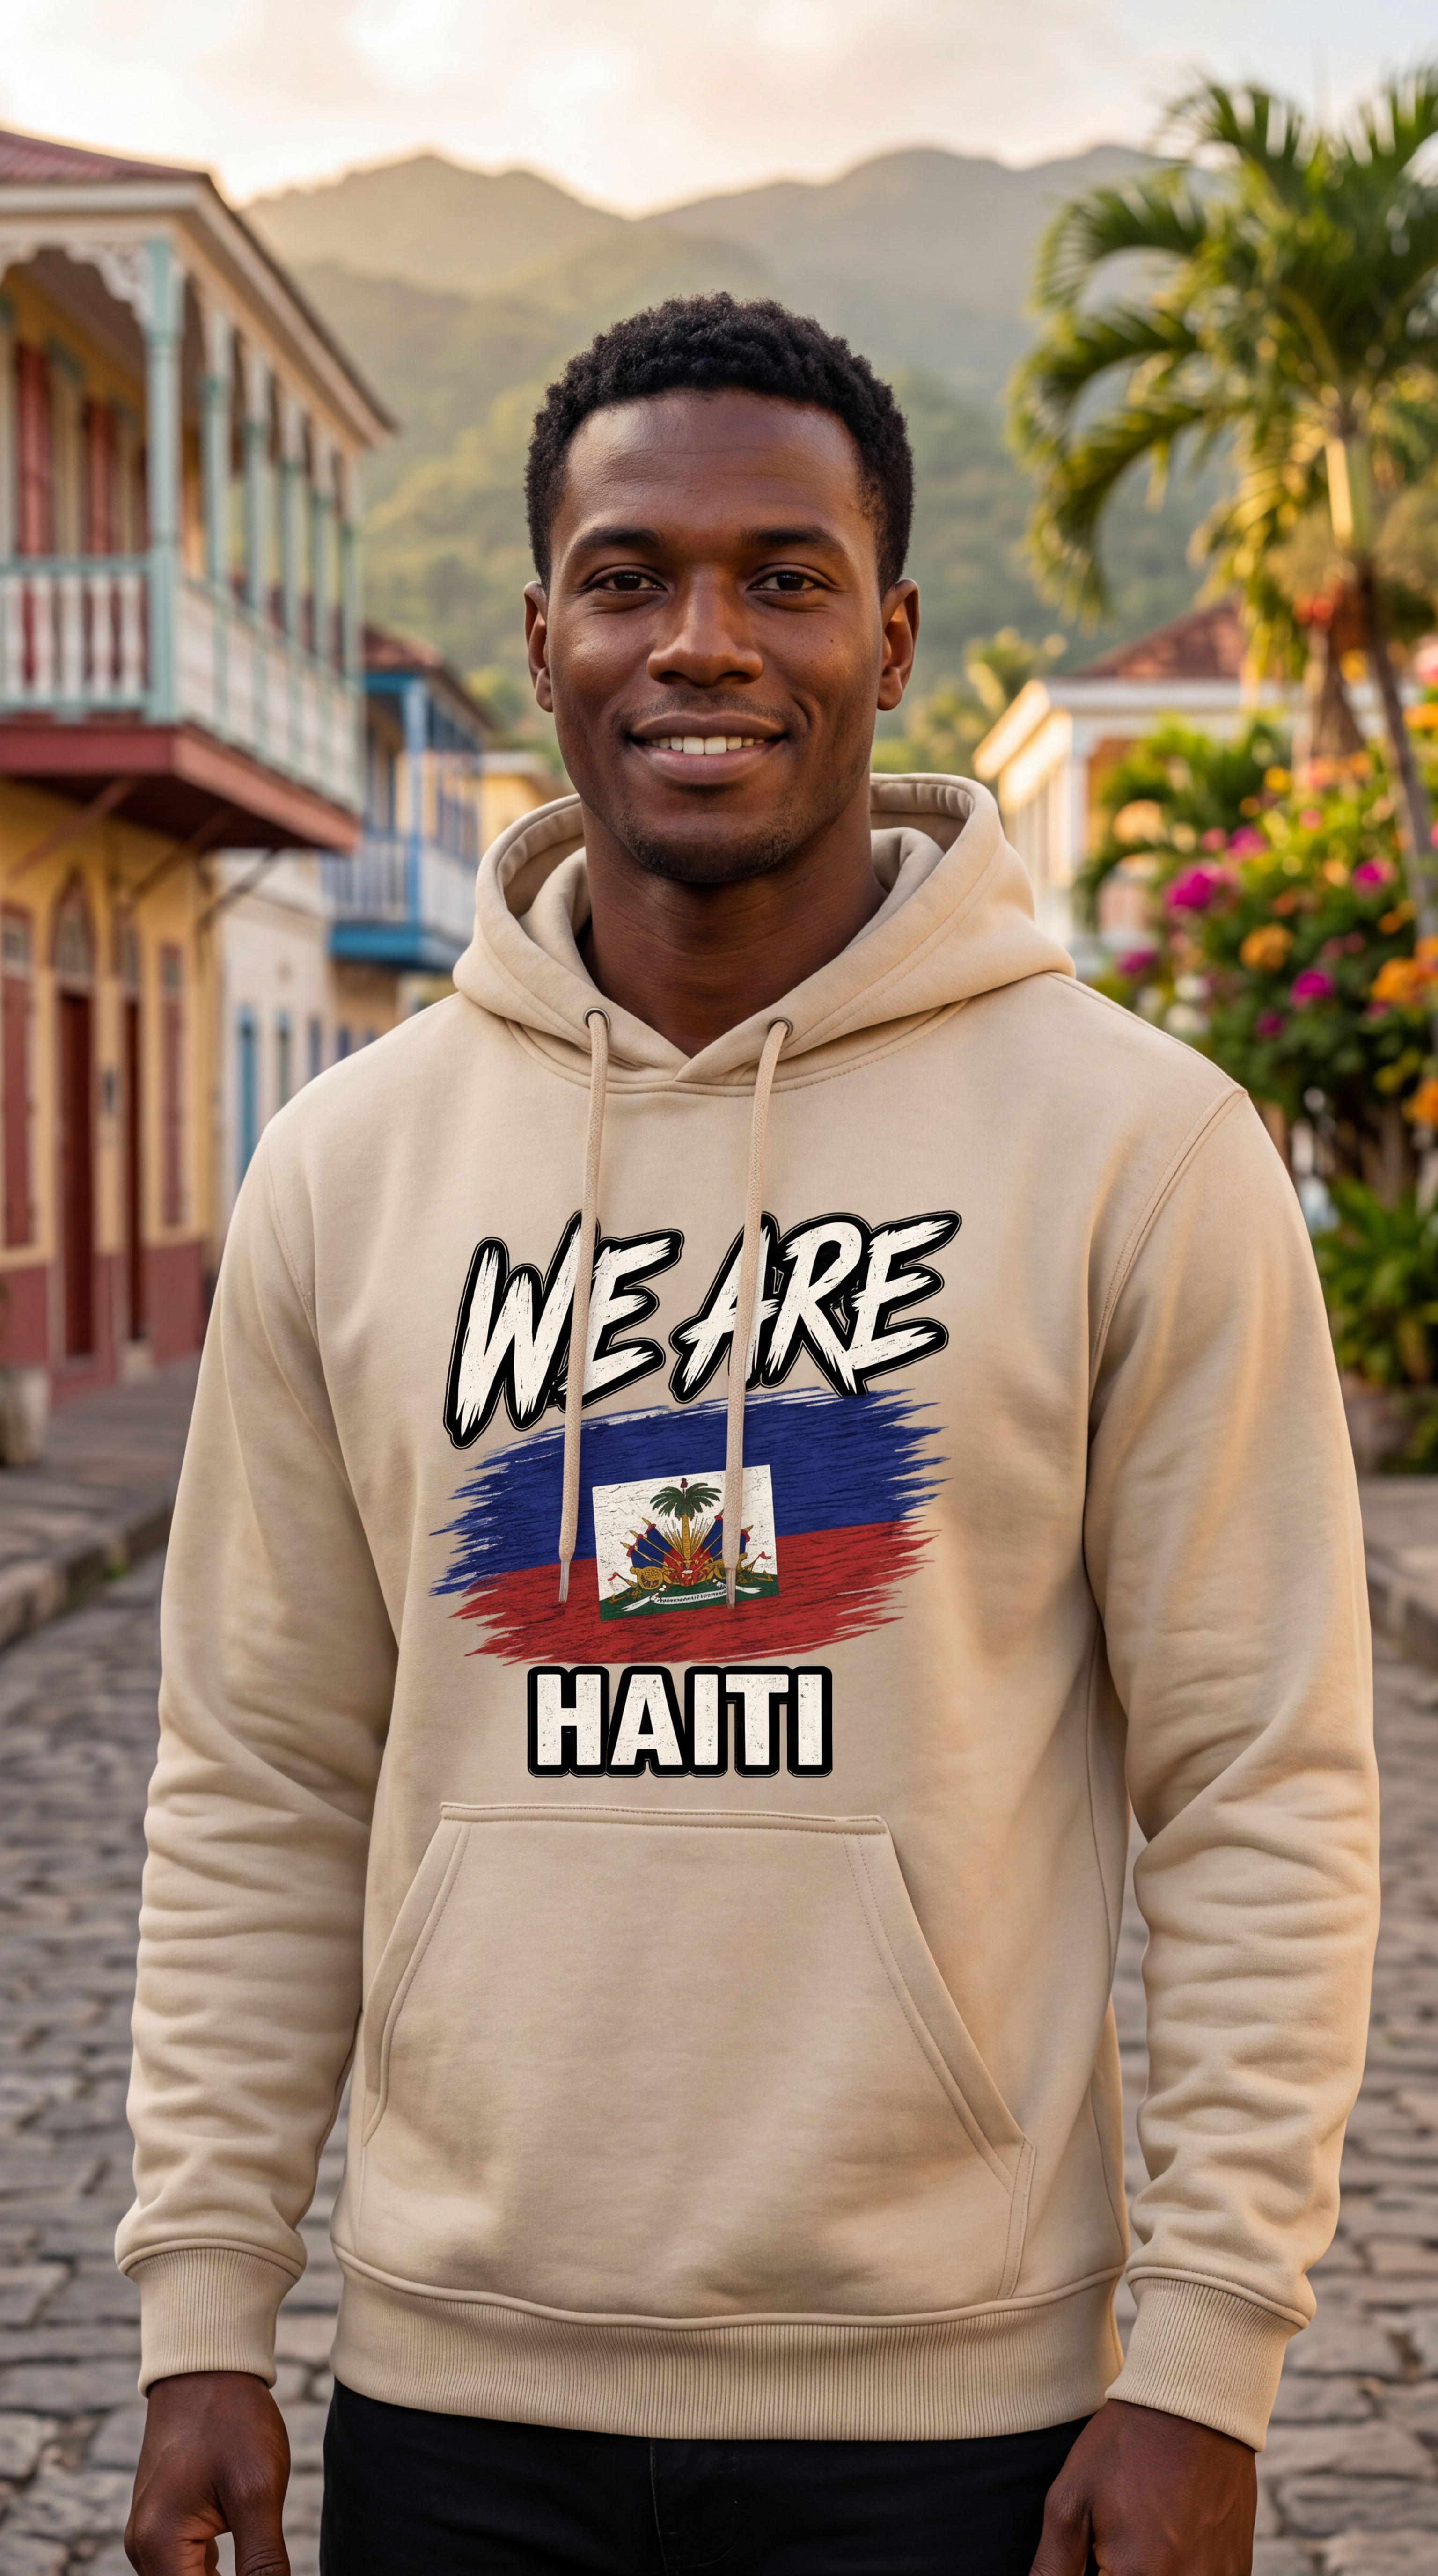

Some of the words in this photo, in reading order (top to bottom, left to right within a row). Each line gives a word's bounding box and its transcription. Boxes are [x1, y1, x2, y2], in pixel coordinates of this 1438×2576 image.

[444, 1211, 684, 1449] WE
[669, 1211, 961, 1402] ARE
[528, 1666, 832, 1777] HAITI
